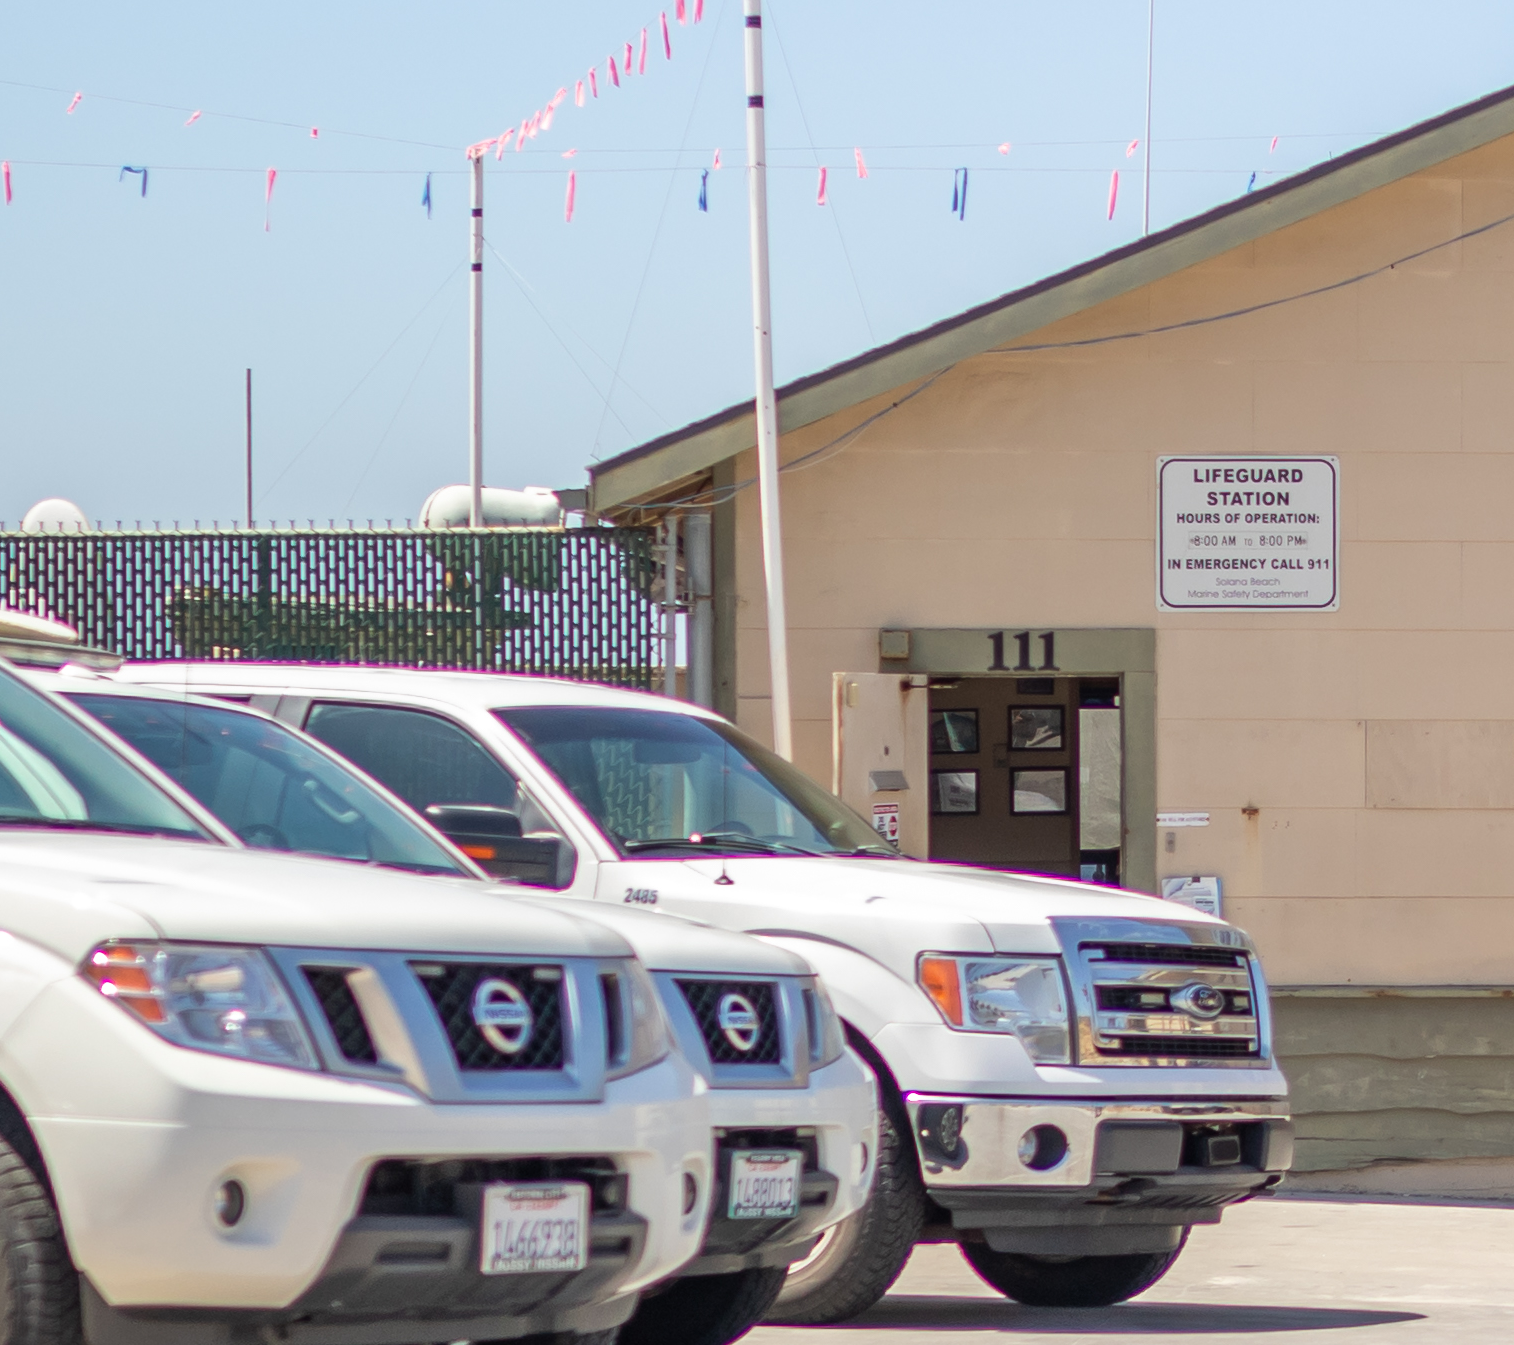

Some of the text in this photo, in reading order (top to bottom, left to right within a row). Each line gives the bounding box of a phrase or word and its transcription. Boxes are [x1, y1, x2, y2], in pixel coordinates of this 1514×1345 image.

[1193, 468, 1303, 483] LIFEGUARD
[1207, 491, 1290, 506] STATION
[1176, 513, 1320, 524] HOURS OF OPERATION:
[1221, 535, 1236, 546] AM
[1259, 535, 1283, 546] 8:00
[1286, 535, 1303, 546] PM
[1167, 558, 1329, 570] IN EMERGENCY CALL 911
[1215, 577, 1281, 586] Solana Beach
[1187, 589, 1309, 600] Marine Safety Department
[987, 630, 1060, 672] 111
